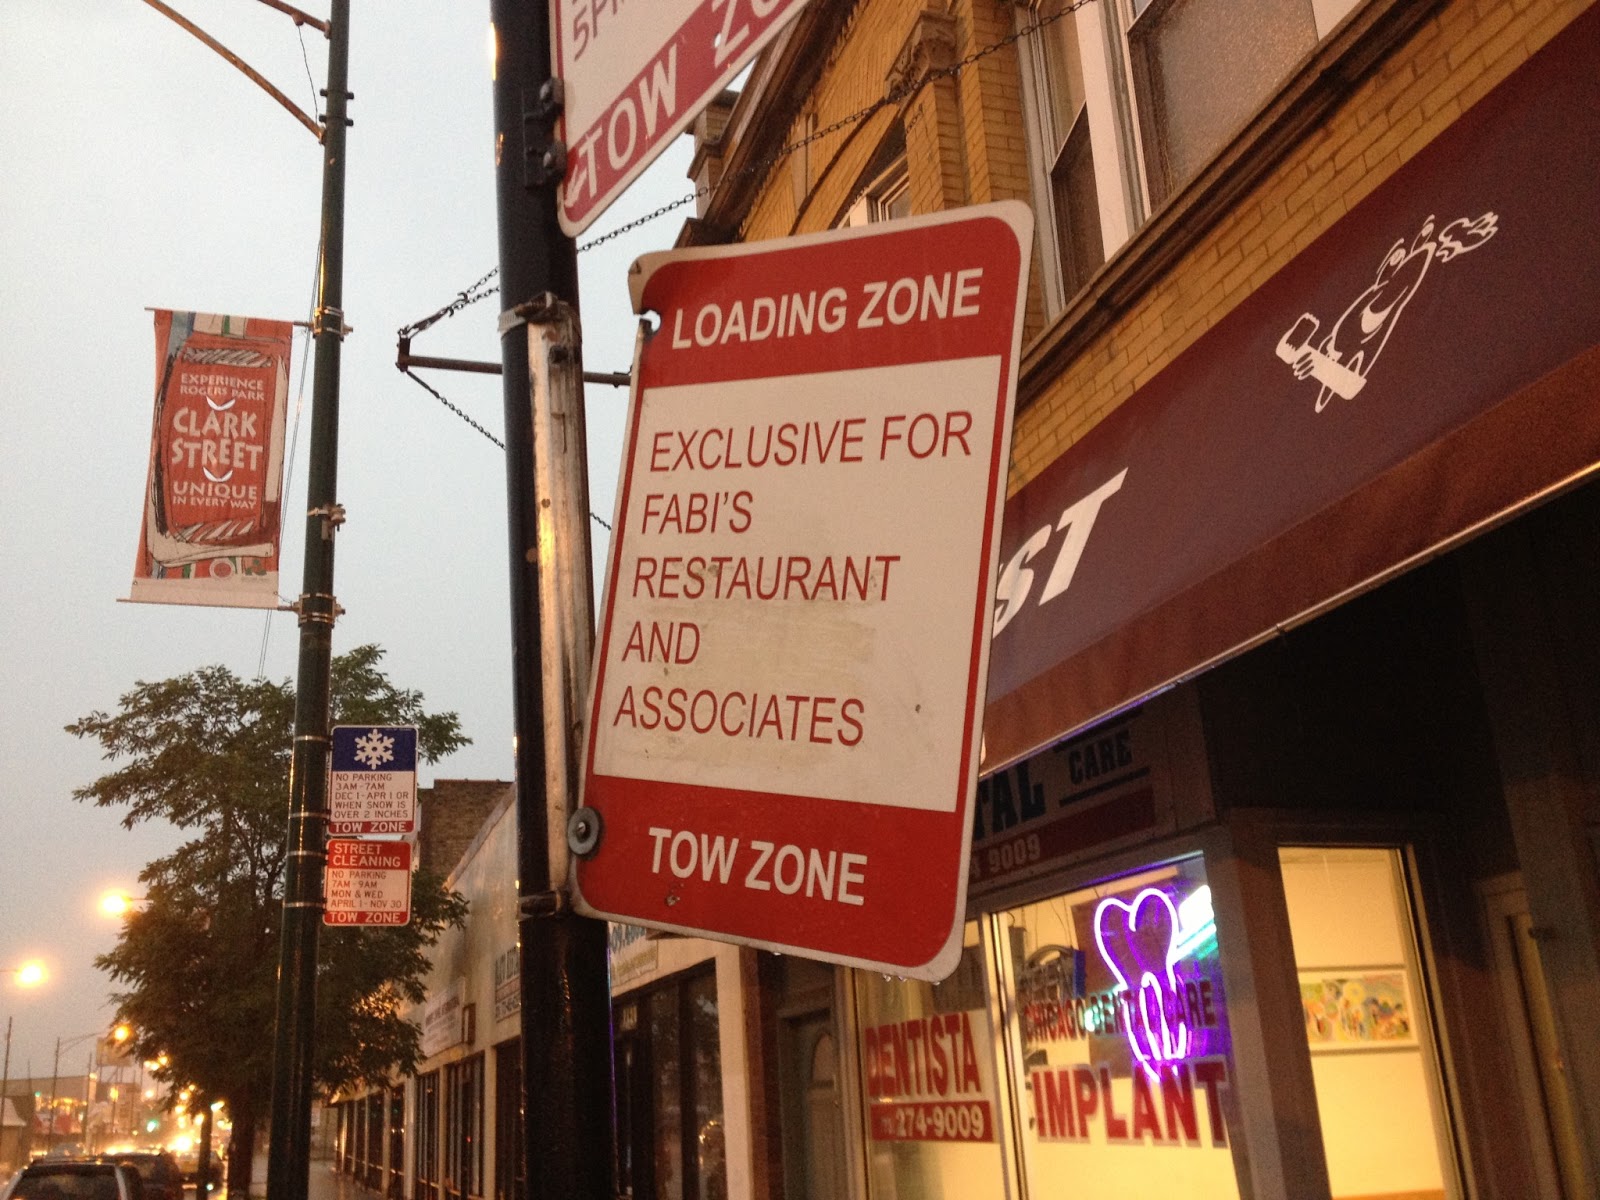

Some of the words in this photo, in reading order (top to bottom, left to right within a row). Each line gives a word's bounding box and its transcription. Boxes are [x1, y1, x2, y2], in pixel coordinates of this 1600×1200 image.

[573, 0, 624, 61] 5P
[578, 43, 677, 199] TOW
[672, 287, 848, 350] LOADING
[857, 267, 984, 329] ZONE
[180, 385, 228, 397] ROGERS
[231, 389, 265, 401] PARK
[181, 372, 264, 391] EXPERIENCE
[173, 406, 257, 439] CLARK
[171, 437, 264, 472] STREET
[650, 417, 867, 473] EXCLUSIVE
[879, 410, 973, 461] FOR
[172, 481, 258, 500] UNIQUE
[172, 495, 187, 505] IN
[191, 496, 229, 507] EVERY
[230, 500, 257, 510] WAY
[641, 490, 754, 534] FABI'S
[992, 466, 1129, 641] ST
[632, 555, 901, 602] RESTAURANT
[621, 621, 701, 665] AND
[613, 685, 866, 747] ASSOCIATES
[1068, 730, 1133, 784] CARE
[335, 773, 349, 781] NO
[352, 773, 393, 782] PARKING
[334, 801, 362, 809] WHEN
[367, 801, 393, 809] SNOW
[397, 800, 406, 809] IS
[335, 791, 353, 800] DEC
[396, 791, 409, 800] OR
[333, 822, 363, 833] TOW
[369, 821, 407, 833] ZONE
[334, 810, 360, 819] OVER
[363, 810, 371, 818] 2
[374, 809, 409, 818] INCHES
[332, 854, 401, 868] CLEANING
[334, 842, 383, 855] STREET
[988, 834, 1041, 873] 9009
[331, 870, 345, 879] NO
[349, 871, 387, 879] PARKING
[648, 826, 739, 884] TOW
[744, 839, 868, 907] ZONE
[330, 899, 356, 908] APRIL
[370, 900, 388, 908] NOV
[390, 900, 402, 909] 30
[331, 890, 352, 898] MON
[354, 890, 361, 898] &
[364, 890, 384, 899] WED
[330, 912, 358, 923] TOW
[364, 912, 401, 923] ZONE
[1165, 979, 1218, 1029] ARE
[864, 1011, 982, 1098] DENTISTA
[1030, 1058, 1230, 1148] IMPLANT
[895, 1104, 985, 1139] 274-9009
